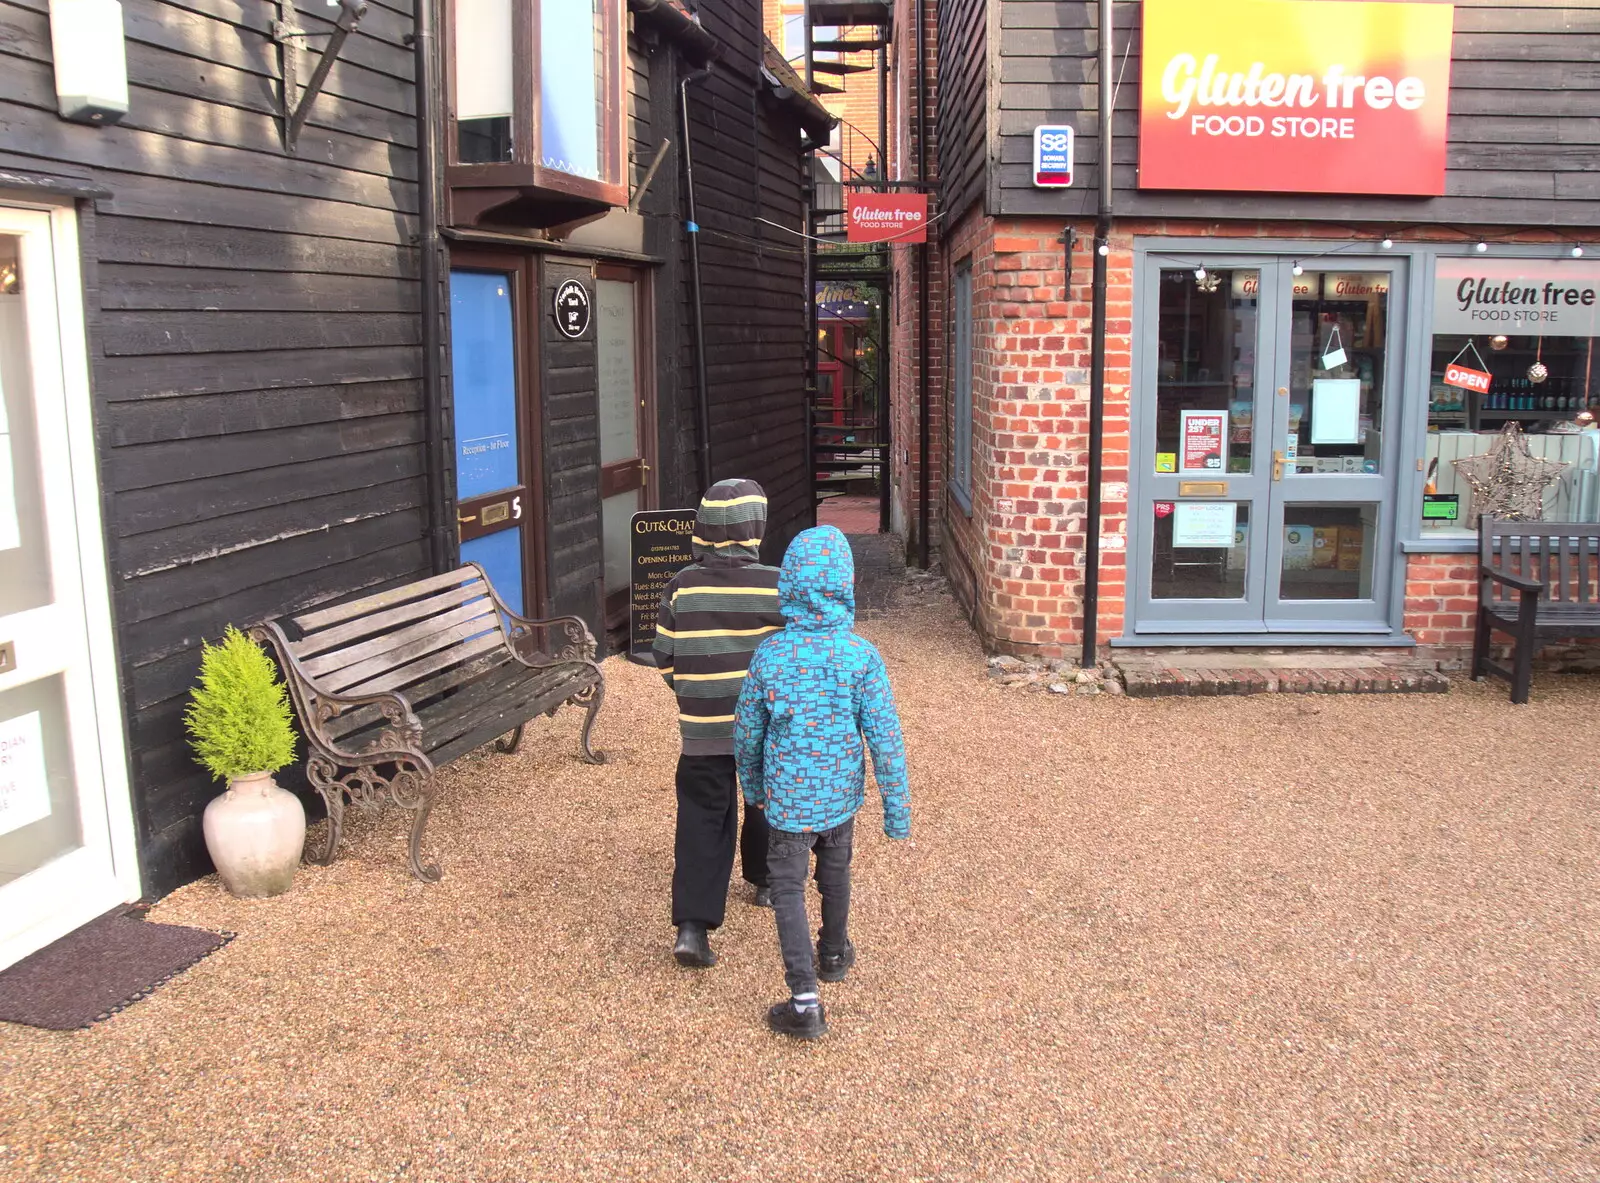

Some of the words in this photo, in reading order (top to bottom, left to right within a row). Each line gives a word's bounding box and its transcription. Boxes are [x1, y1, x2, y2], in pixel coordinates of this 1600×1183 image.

[1161, 53, 1319, 120] Gluten
[1322, 64, 1425, 110] free
[1190, 115, 1265, 136] FOOD
[1270, 116, 1355, 139] STORE
[852, 206, 894, 224] Gluten
[894, 208, 922, 221] free
[860, 221, 880, 229] FOOD
[1243, 280, 1257, 297] Gl
[1293, 285, 1309, 295] ee
[1335, 281, 1373, 298] Gluten
[1456, 276, 1539, 312] Gluten
[1541, 282, 1597, 306] free
[1471, 310, 1511, 321] FOOD
[1513, 310, 1559, 322] STORE
[1447, 368, 1489, 390] OPEN
[1187, 418, 1220, 426] UNDER
[1187, 425, 1205, 433] 25?
[461, 443, 487, 456] Reception
[497, 440, 510, 450] Floor
[512, 495, 522, 519] 5
[1156, 503, 1171, 511] PRS
[635, 518, 696, 535] CUT&CHAT
[637, 554, 668, 565] OPENING
[668, 553, 692, 563] HOURS
[647, 571, 663, 580] Mon:
[634, 583, 650, 591] Tues:
[634, 593, 650, 601] Wed:
[650, 592, 662, 600] 8.45
[632, 603, 650, 611] Thurs:
[640, 613, 650, 621] Fri:
[650, 612, 659, 620] 8.4
[638, 622, 650, 631] Sat:
